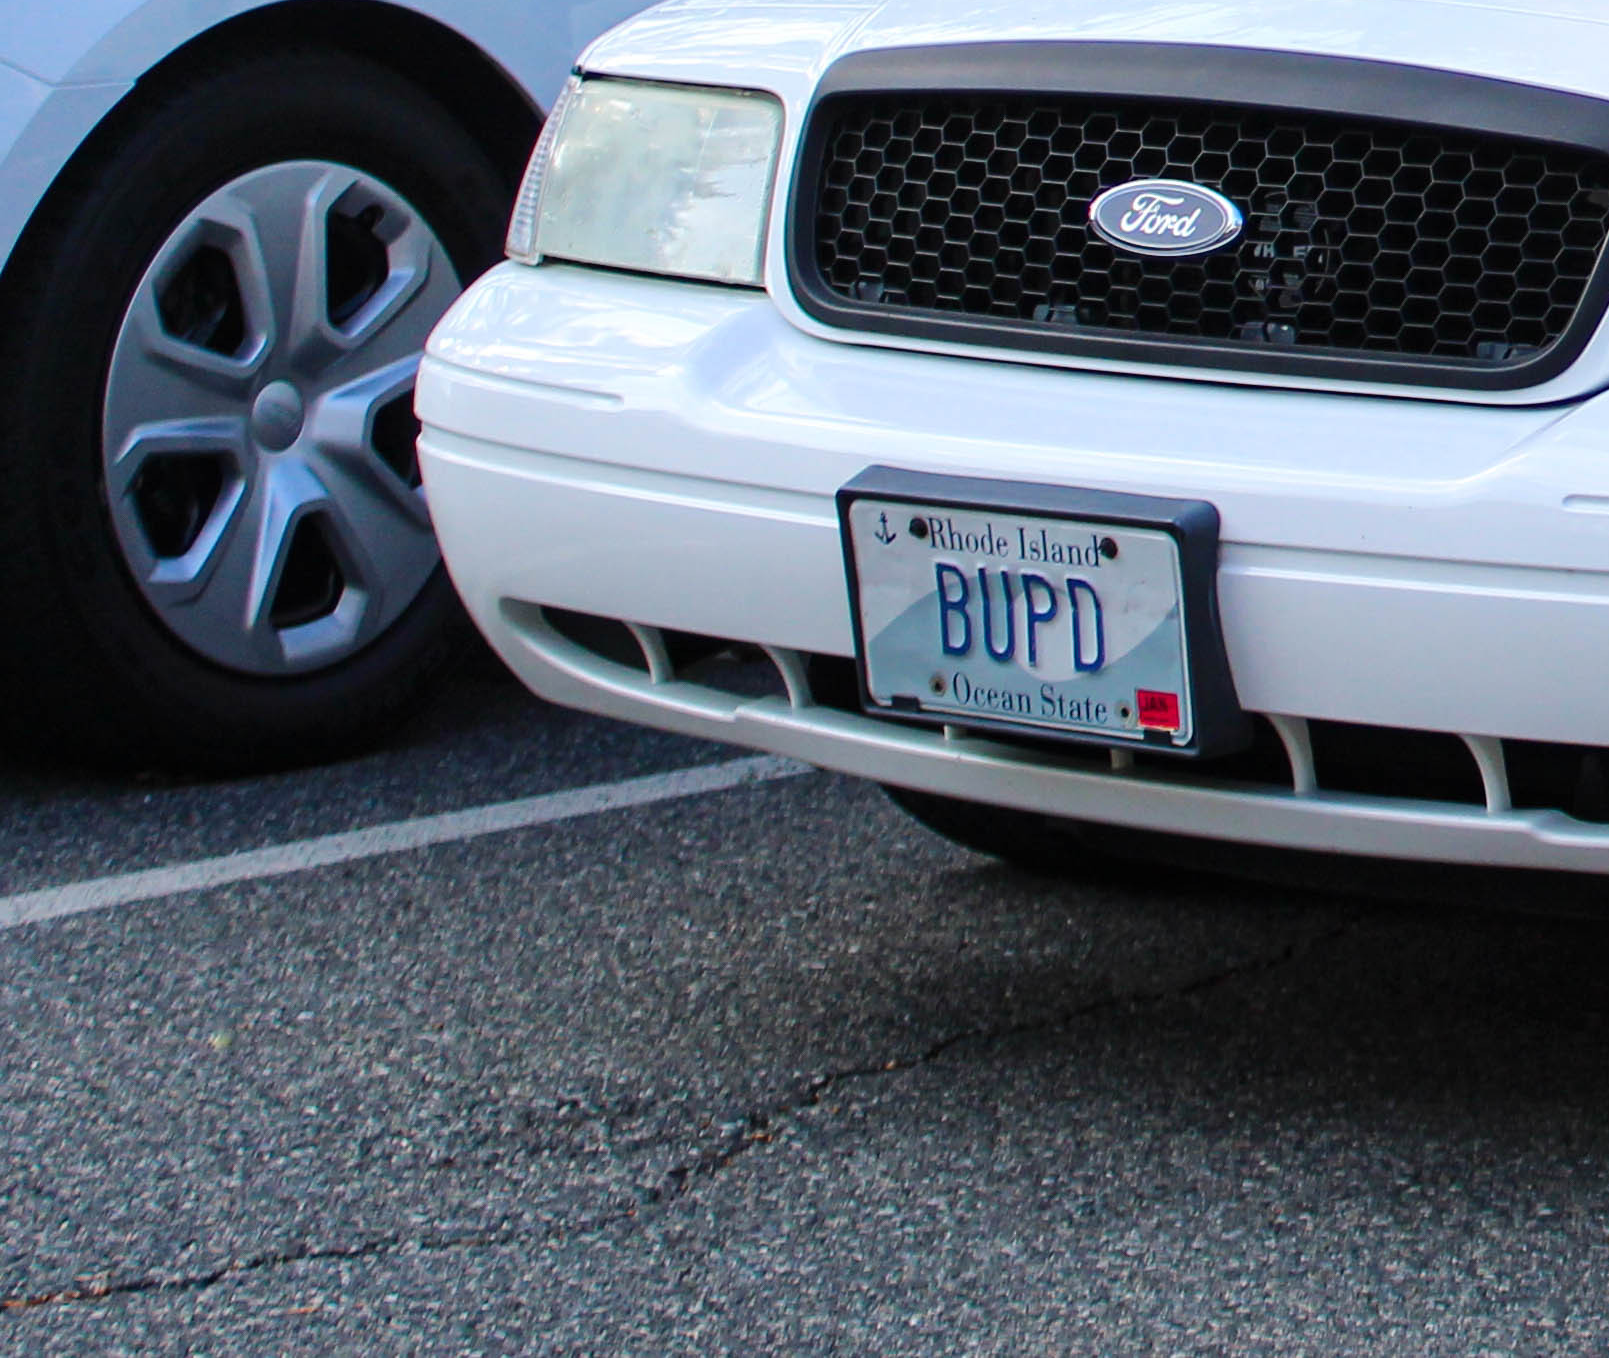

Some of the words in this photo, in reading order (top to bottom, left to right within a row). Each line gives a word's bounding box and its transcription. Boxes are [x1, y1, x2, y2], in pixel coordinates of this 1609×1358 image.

[1121, 193, 1201, 238] Ford
[928, 517, 1009, 558] Rhode
[1017, 527, 1101, 568] Island
[935, 562, 1106, 674] BUPD
[952, 671, 1031, 714] Ocean
[1040, 684, 1107, 723] State
